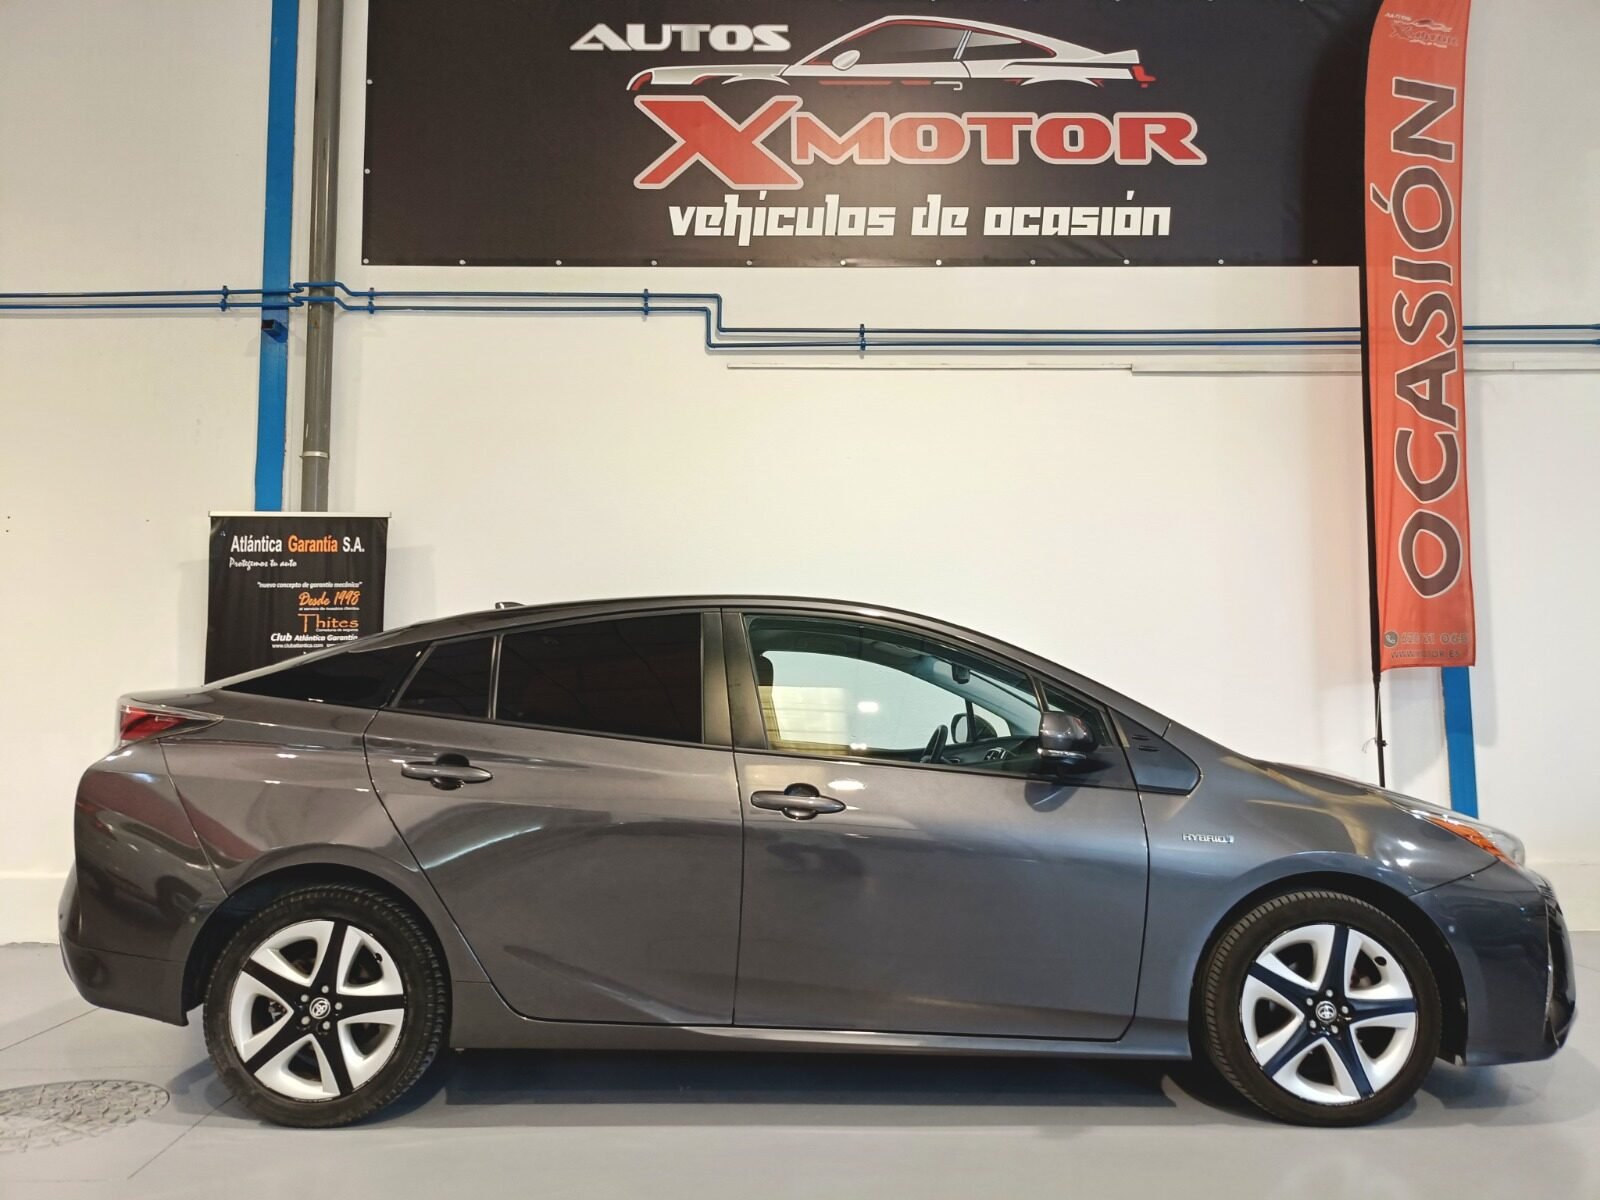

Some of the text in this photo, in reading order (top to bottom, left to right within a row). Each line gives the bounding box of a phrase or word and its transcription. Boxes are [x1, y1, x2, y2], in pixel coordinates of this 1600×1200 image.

[570, 23, 791, 52] AUTOS
[669, 190, 1171, 247] vehículos de ocasión
[1370, 76, 1463, 599] OCASIÓN
[230, 534, 365, 553] Atlántica Garantía S.A.
[269, 558, 278, 567] tu
[279, 558, 297, 567] auto
[298, 590, 361, 606] Desde 1998
[297, 613, 359, 633] Thites
[270, 632, 292, 642] Club
[294, 633, 326, 642] Atlántica
[1182, 833, 1227, 843] HYBRID
